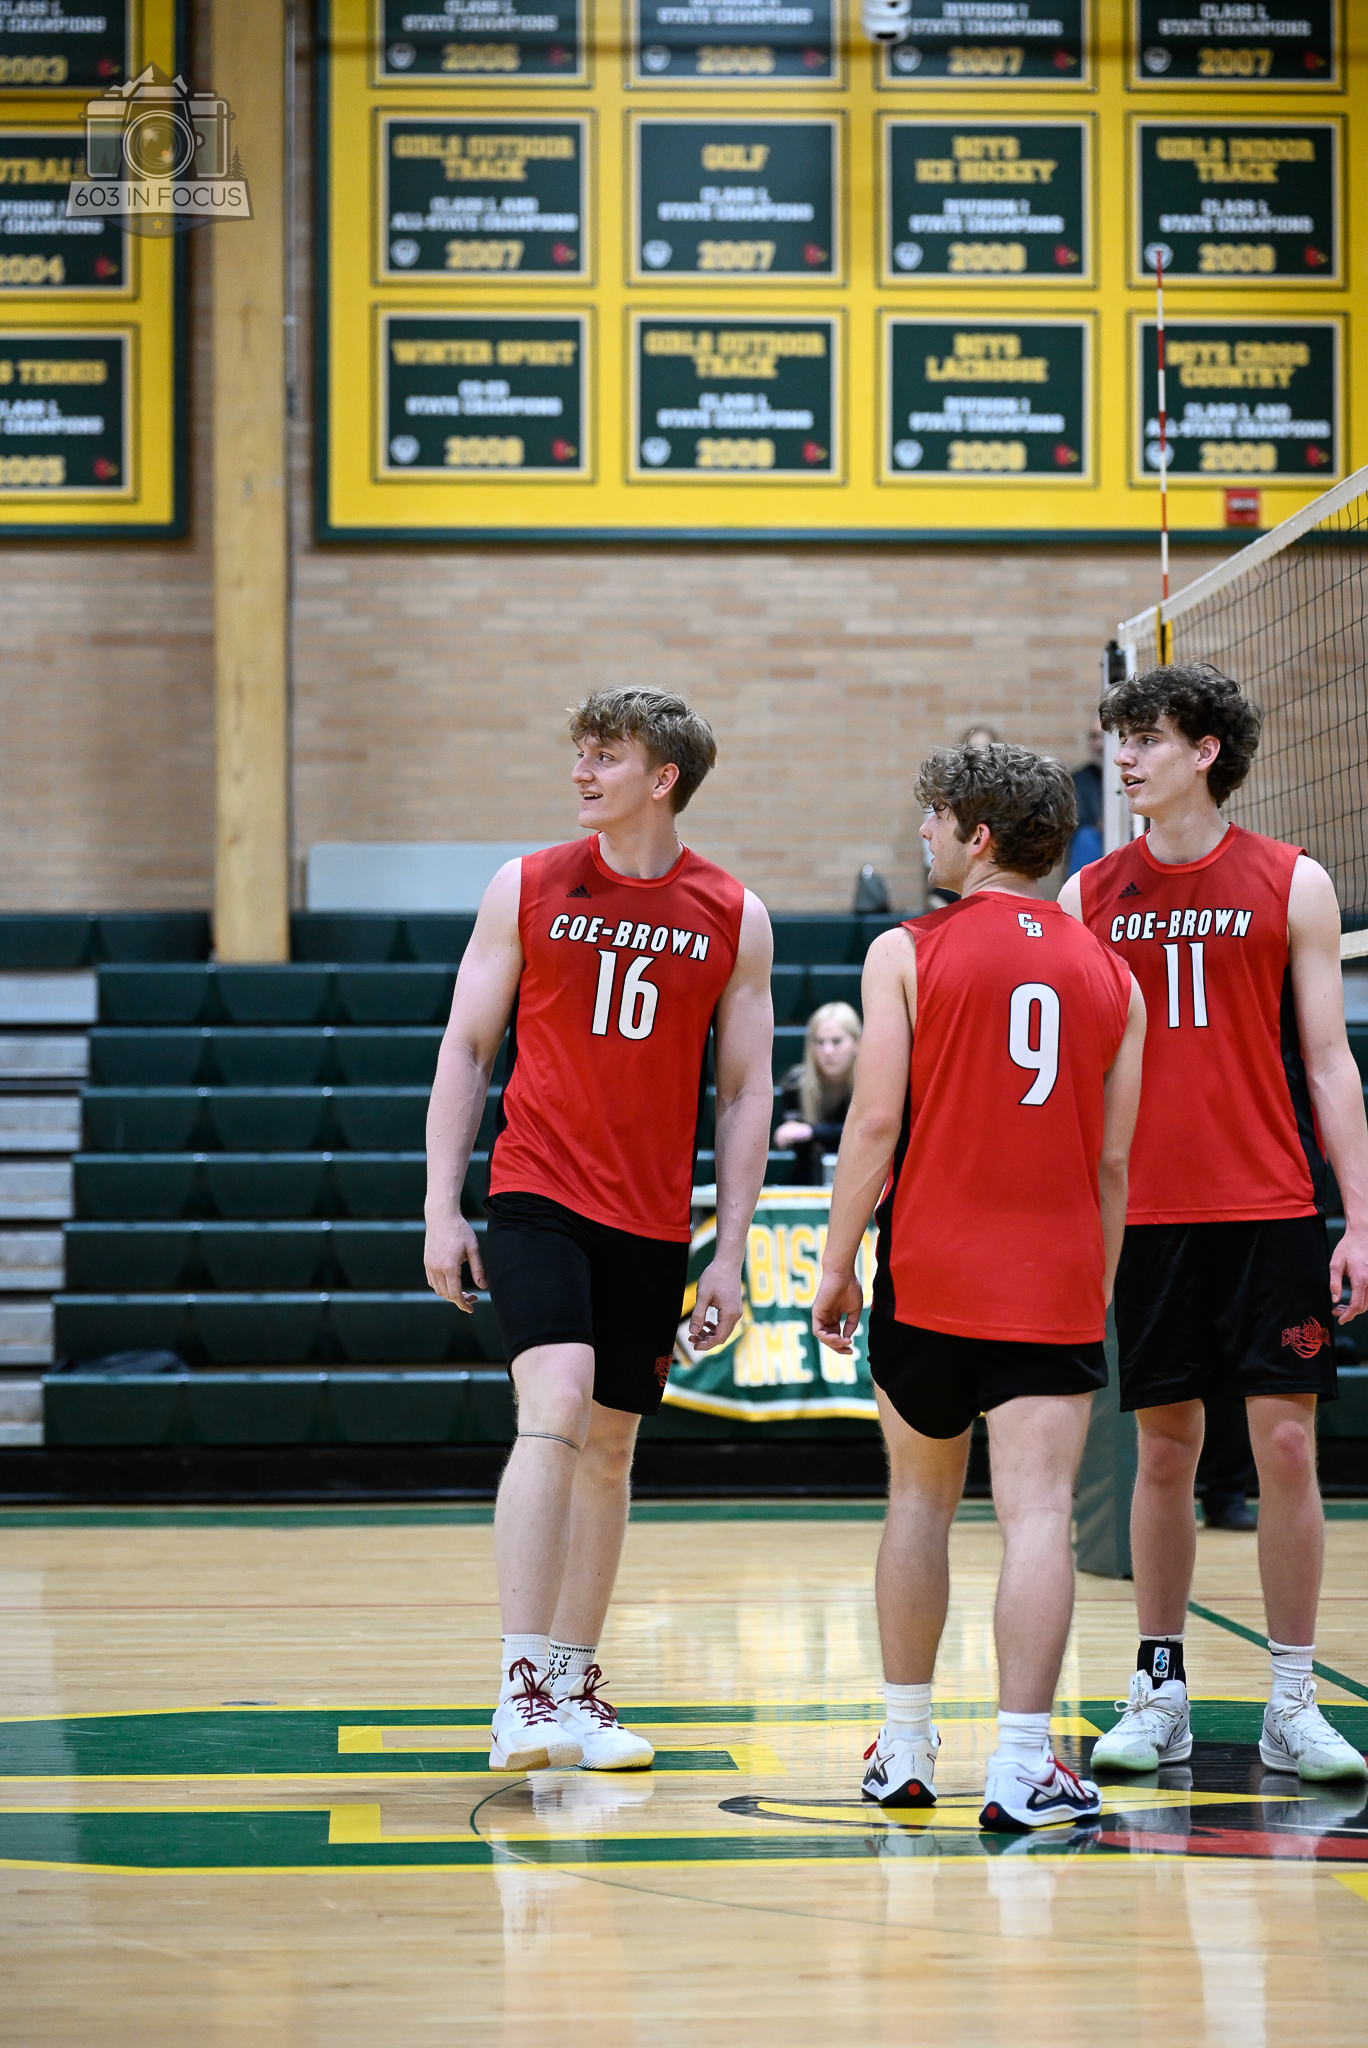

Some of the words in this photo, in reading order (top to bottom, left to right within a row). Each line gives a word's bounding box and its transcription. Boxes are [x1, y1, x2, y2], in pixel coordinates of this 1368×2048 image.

[1214, 19, 1312, 36] CHAMPIONS
[1198, 48, 1274, 76] 2007
[442, 159, 529, 182] TRACK
[701, 143, 771, 171] GOLF
[958, 158, 1059, 184] HOCKEY
[1194, 160, 1279, 183] TRACK
[392, 339, 494, 367] WINTER
[925, 356, 1050, 383] LACROSSE
[1179, 365, 1296, 389] COUNTRY
[549, 914, 710, 962] COE-BROWN
[1110, 908, 1253, 942] COE-BROWN
[591, 948, 659, 1040] 16
[1160, 941, 1209, 1029] 11
[1008, 982, 1061, 1106] 9
